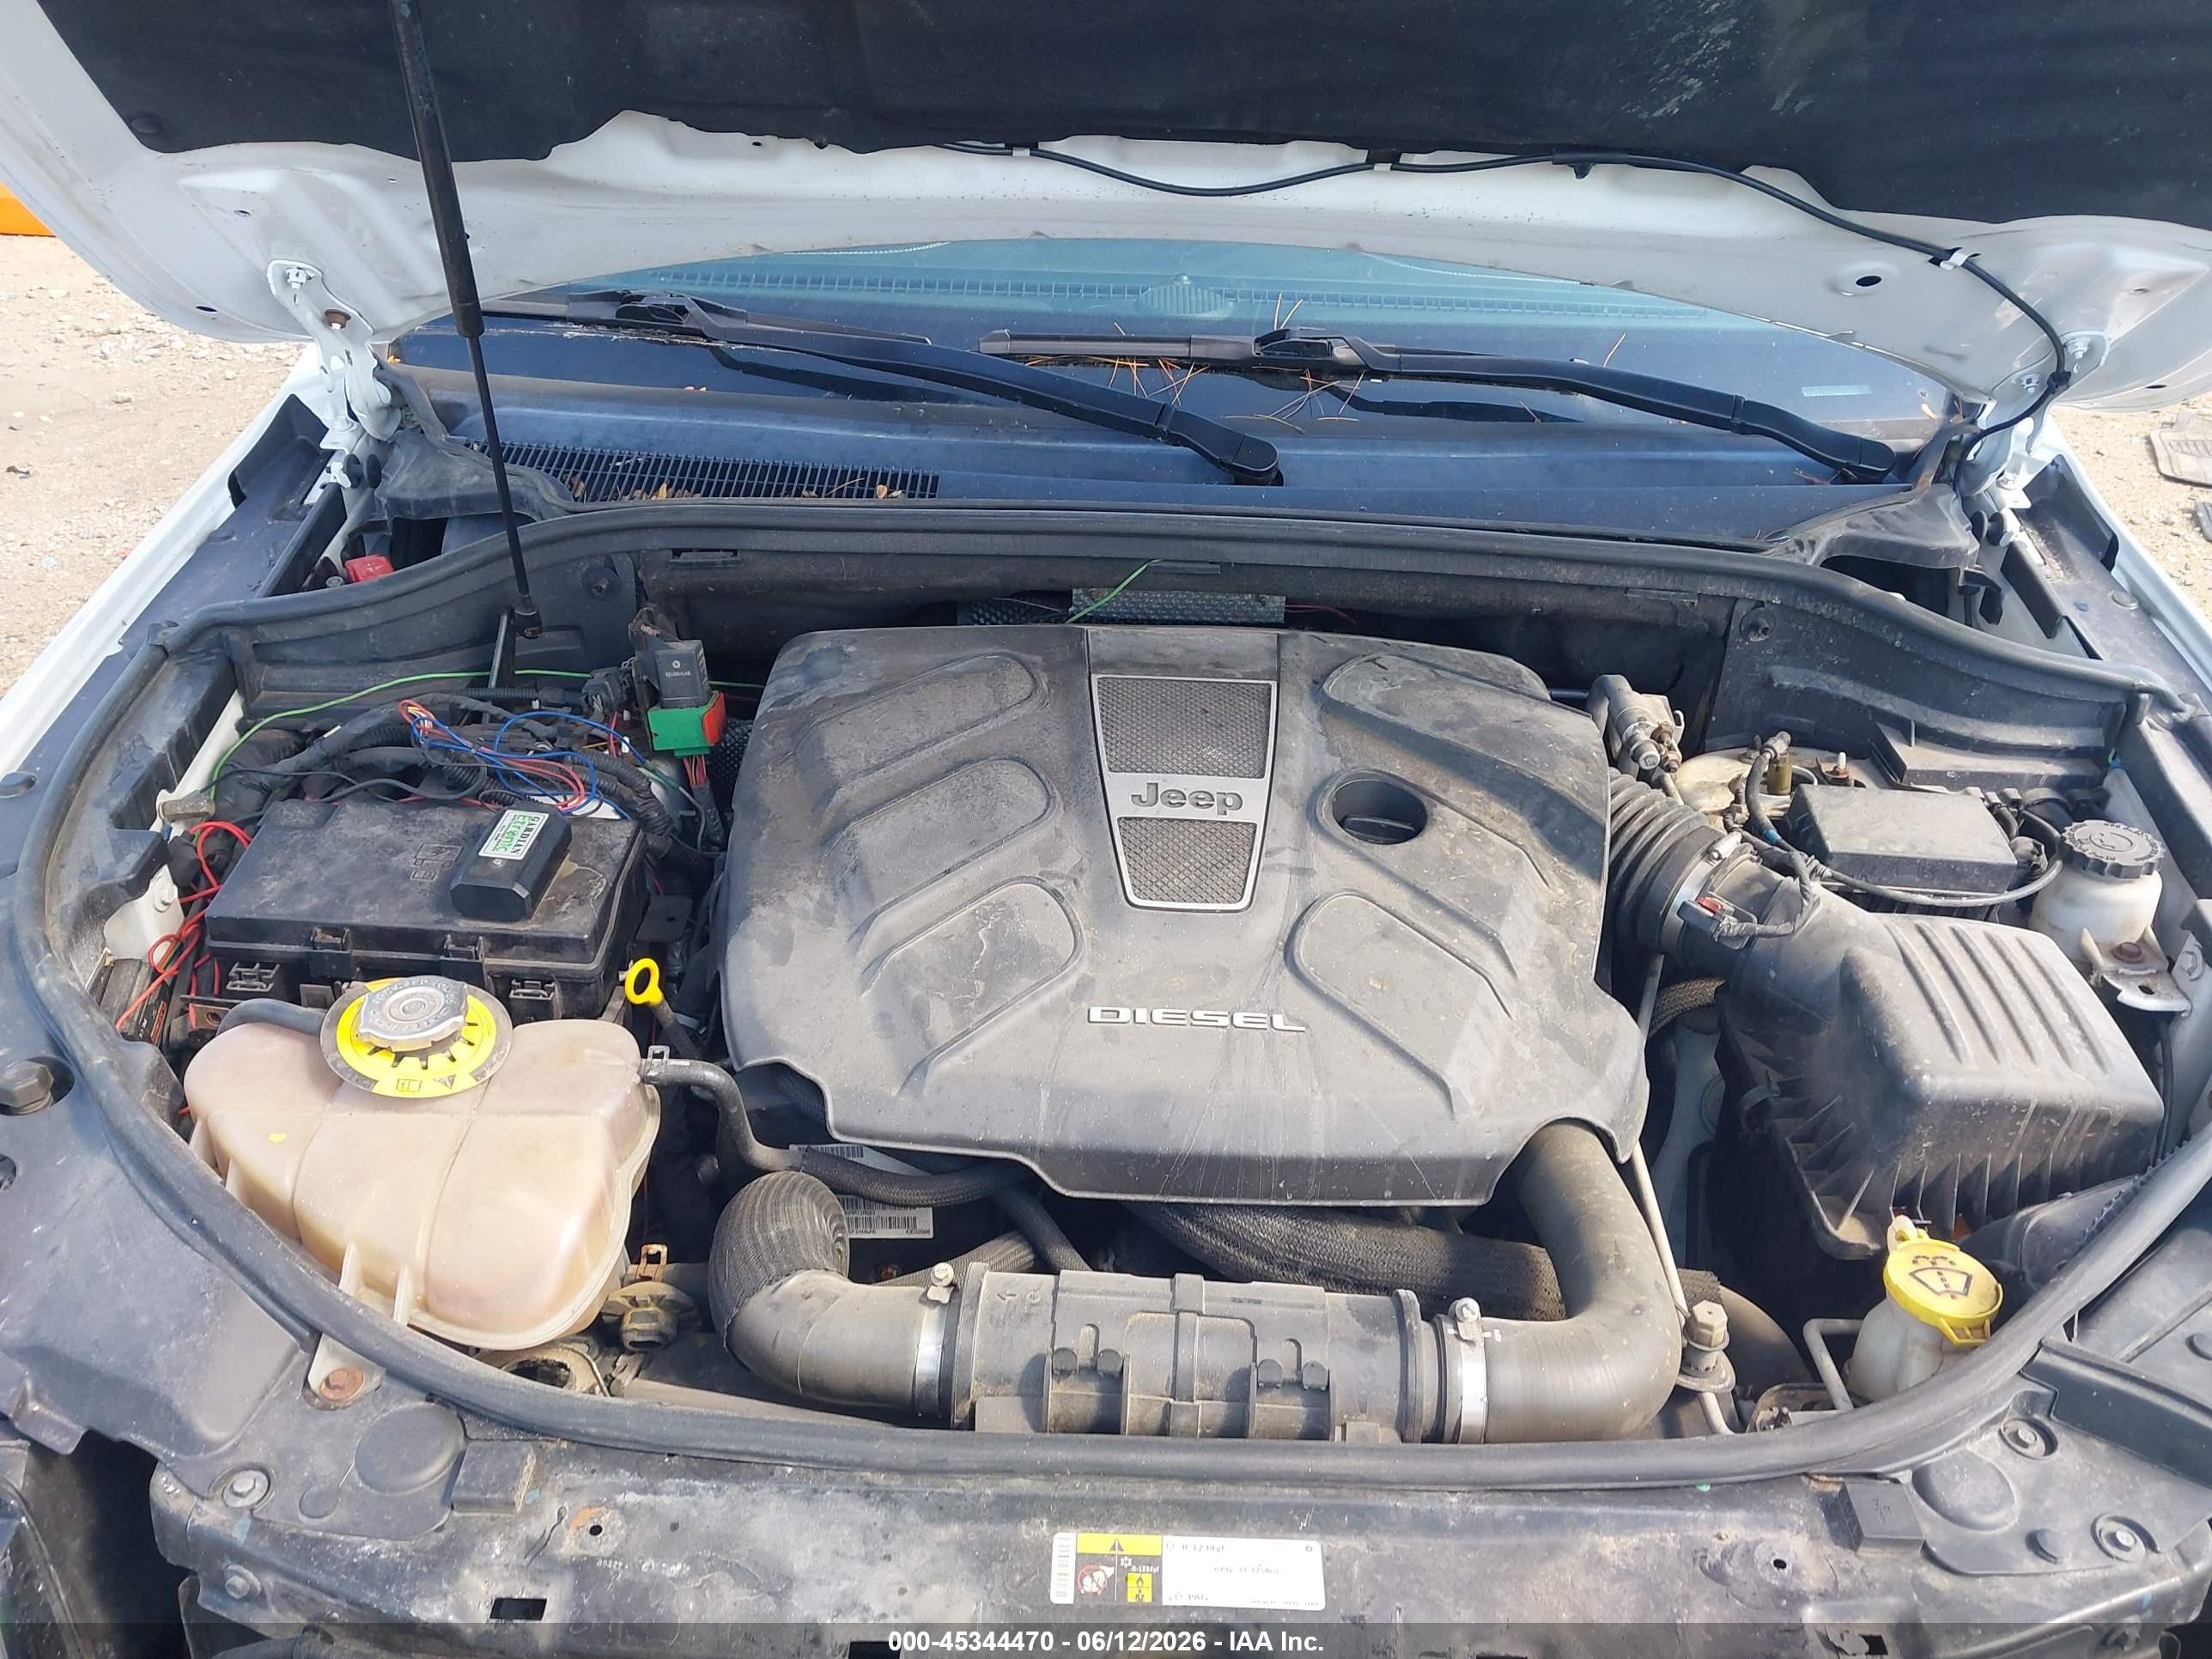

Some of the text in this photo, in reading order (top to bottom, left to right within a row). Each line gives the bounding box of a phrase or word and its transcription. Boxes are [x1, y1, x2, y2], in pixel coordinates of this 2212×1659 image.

[1131, 782, 1243, 816] Jeep
[509, 816, 541, 854] GARDIAN
[1087, 1006, 1305, 1033] DIESEL
